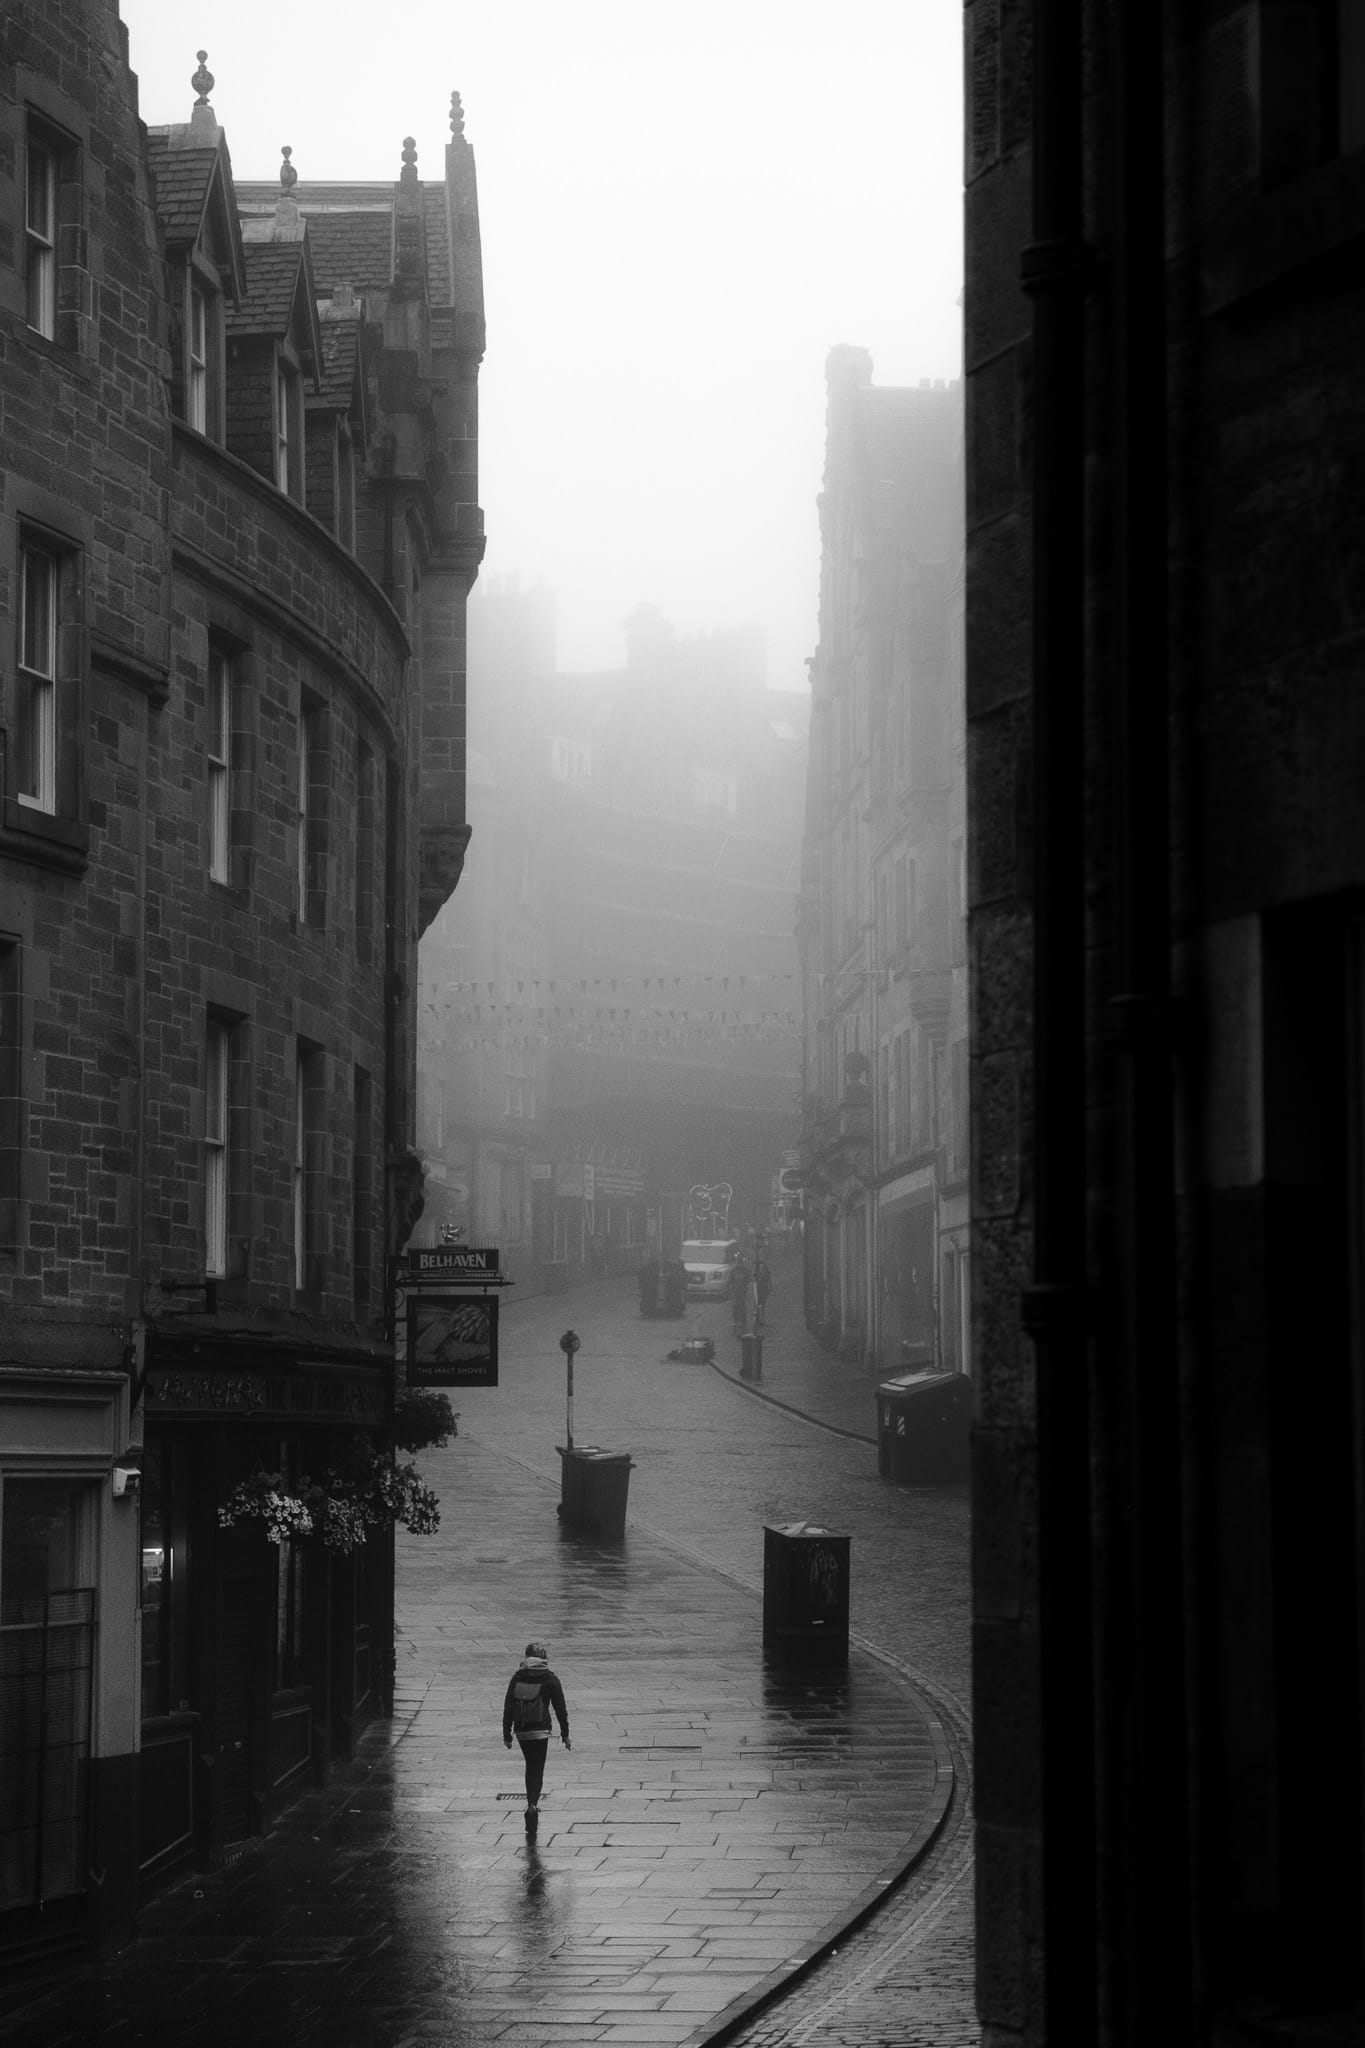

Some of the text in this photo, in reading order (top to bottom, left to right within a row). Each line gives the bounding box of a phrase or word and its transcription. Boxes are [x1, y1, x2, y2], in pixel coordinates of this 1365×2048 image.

[419, 1253, 486, 1270] BELHAVEN
[418, 1367, 433, 1375] THE
[434, 1367, 455, 1375] MALT
